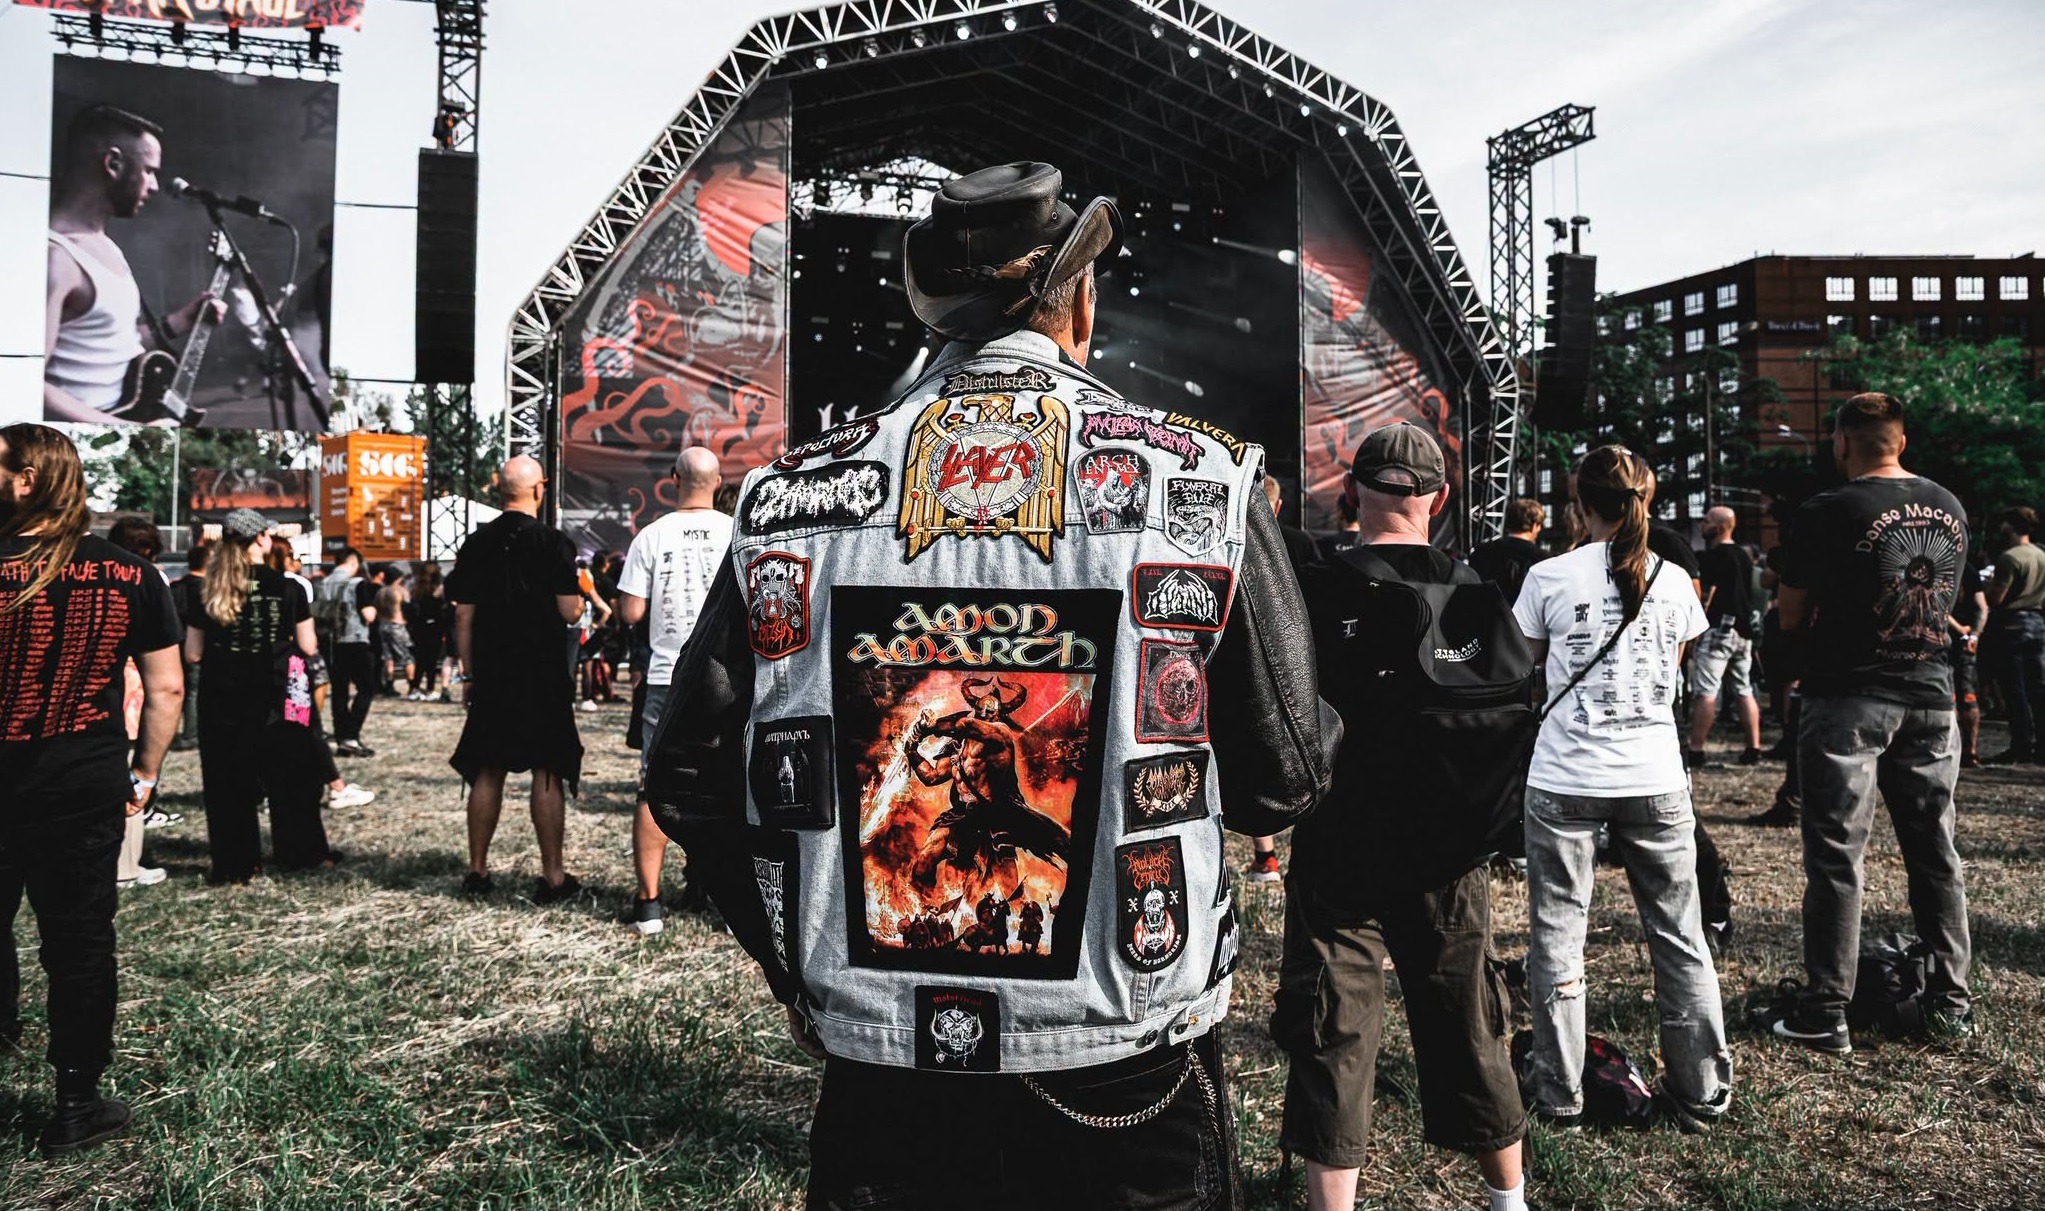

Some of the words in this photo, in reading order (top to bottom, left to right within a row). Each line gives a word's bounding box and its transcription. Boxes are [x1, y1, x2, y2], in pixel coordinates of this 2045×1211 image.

[936, 441, 1037, 493] SLAYER
[1085, 454, 1140, 467] ARCH
[1855, 508, 1901, 553] Danse
